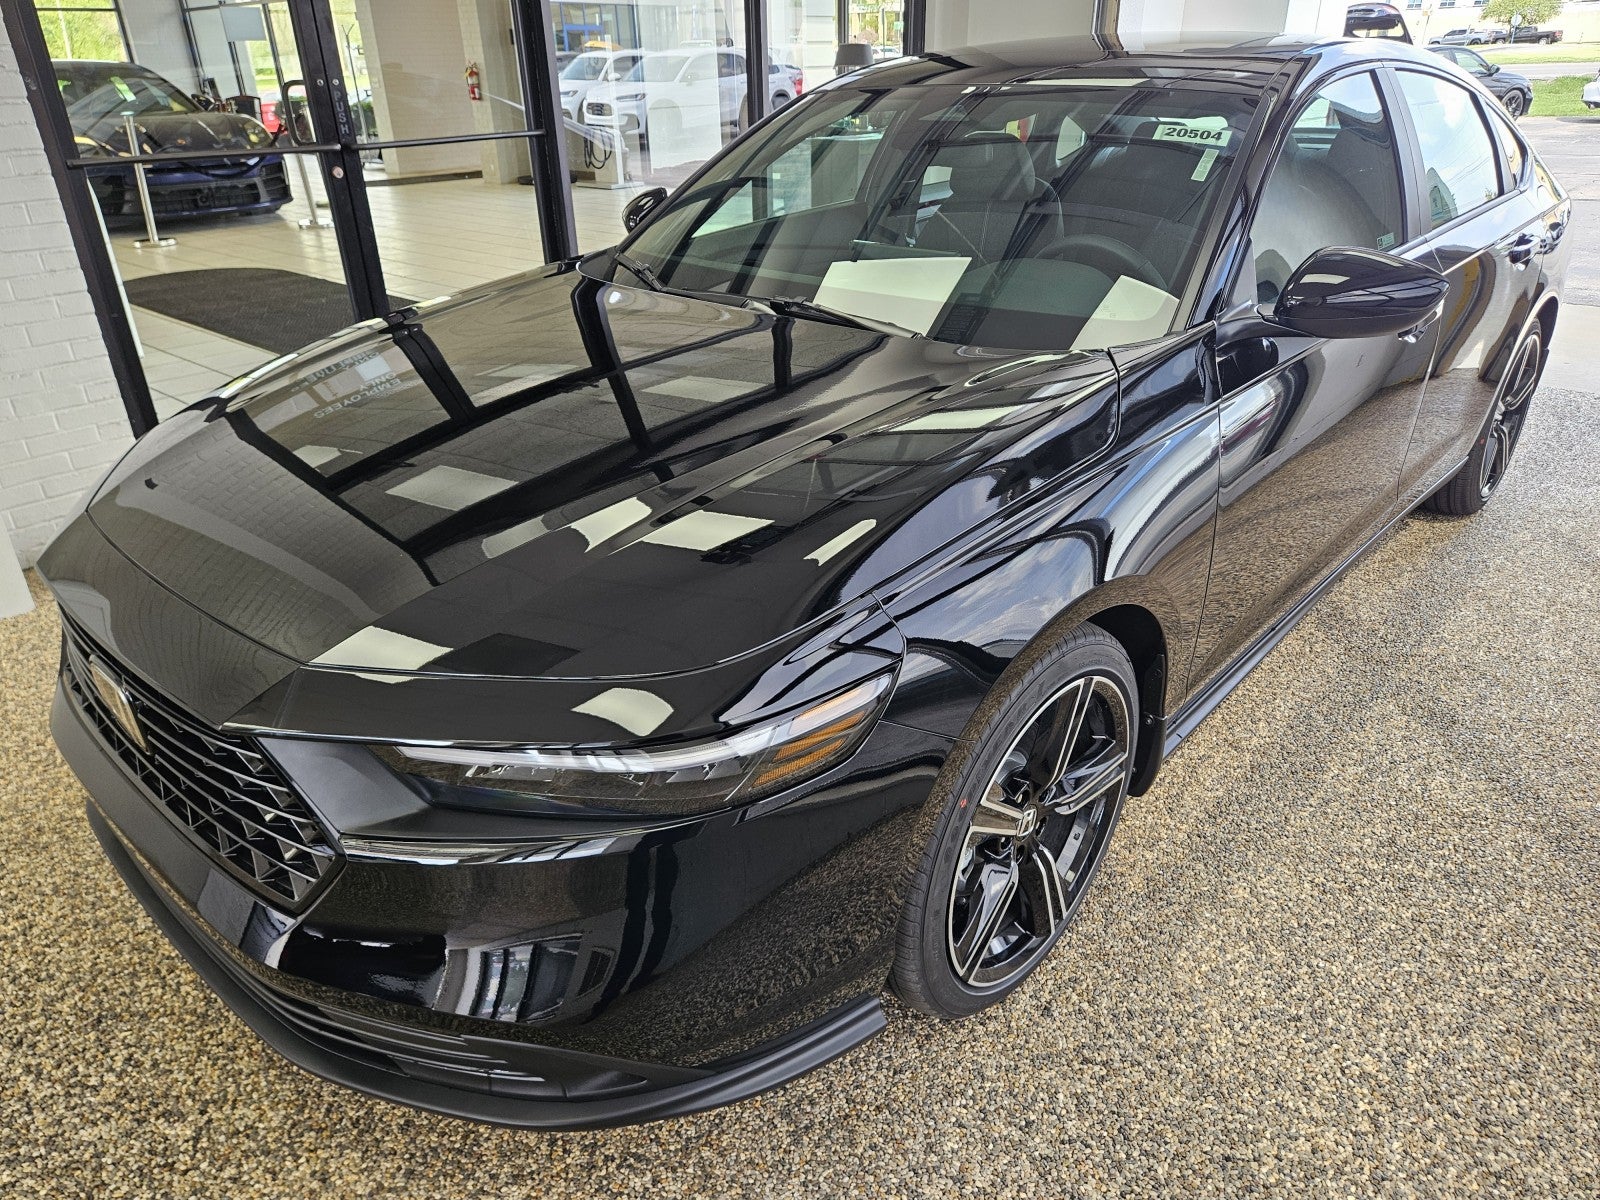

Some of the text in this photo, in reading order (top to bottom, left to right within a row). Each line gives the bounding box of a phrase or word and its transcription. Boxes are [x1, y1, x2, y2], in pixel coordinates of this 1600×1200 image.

[335, 91, 349, 134] PUSH
[1164, 127, 1223, 141] 20504
[360, 373, 397, 390] ONLY
[315, 378, 401, 418] EMPLOYEES
